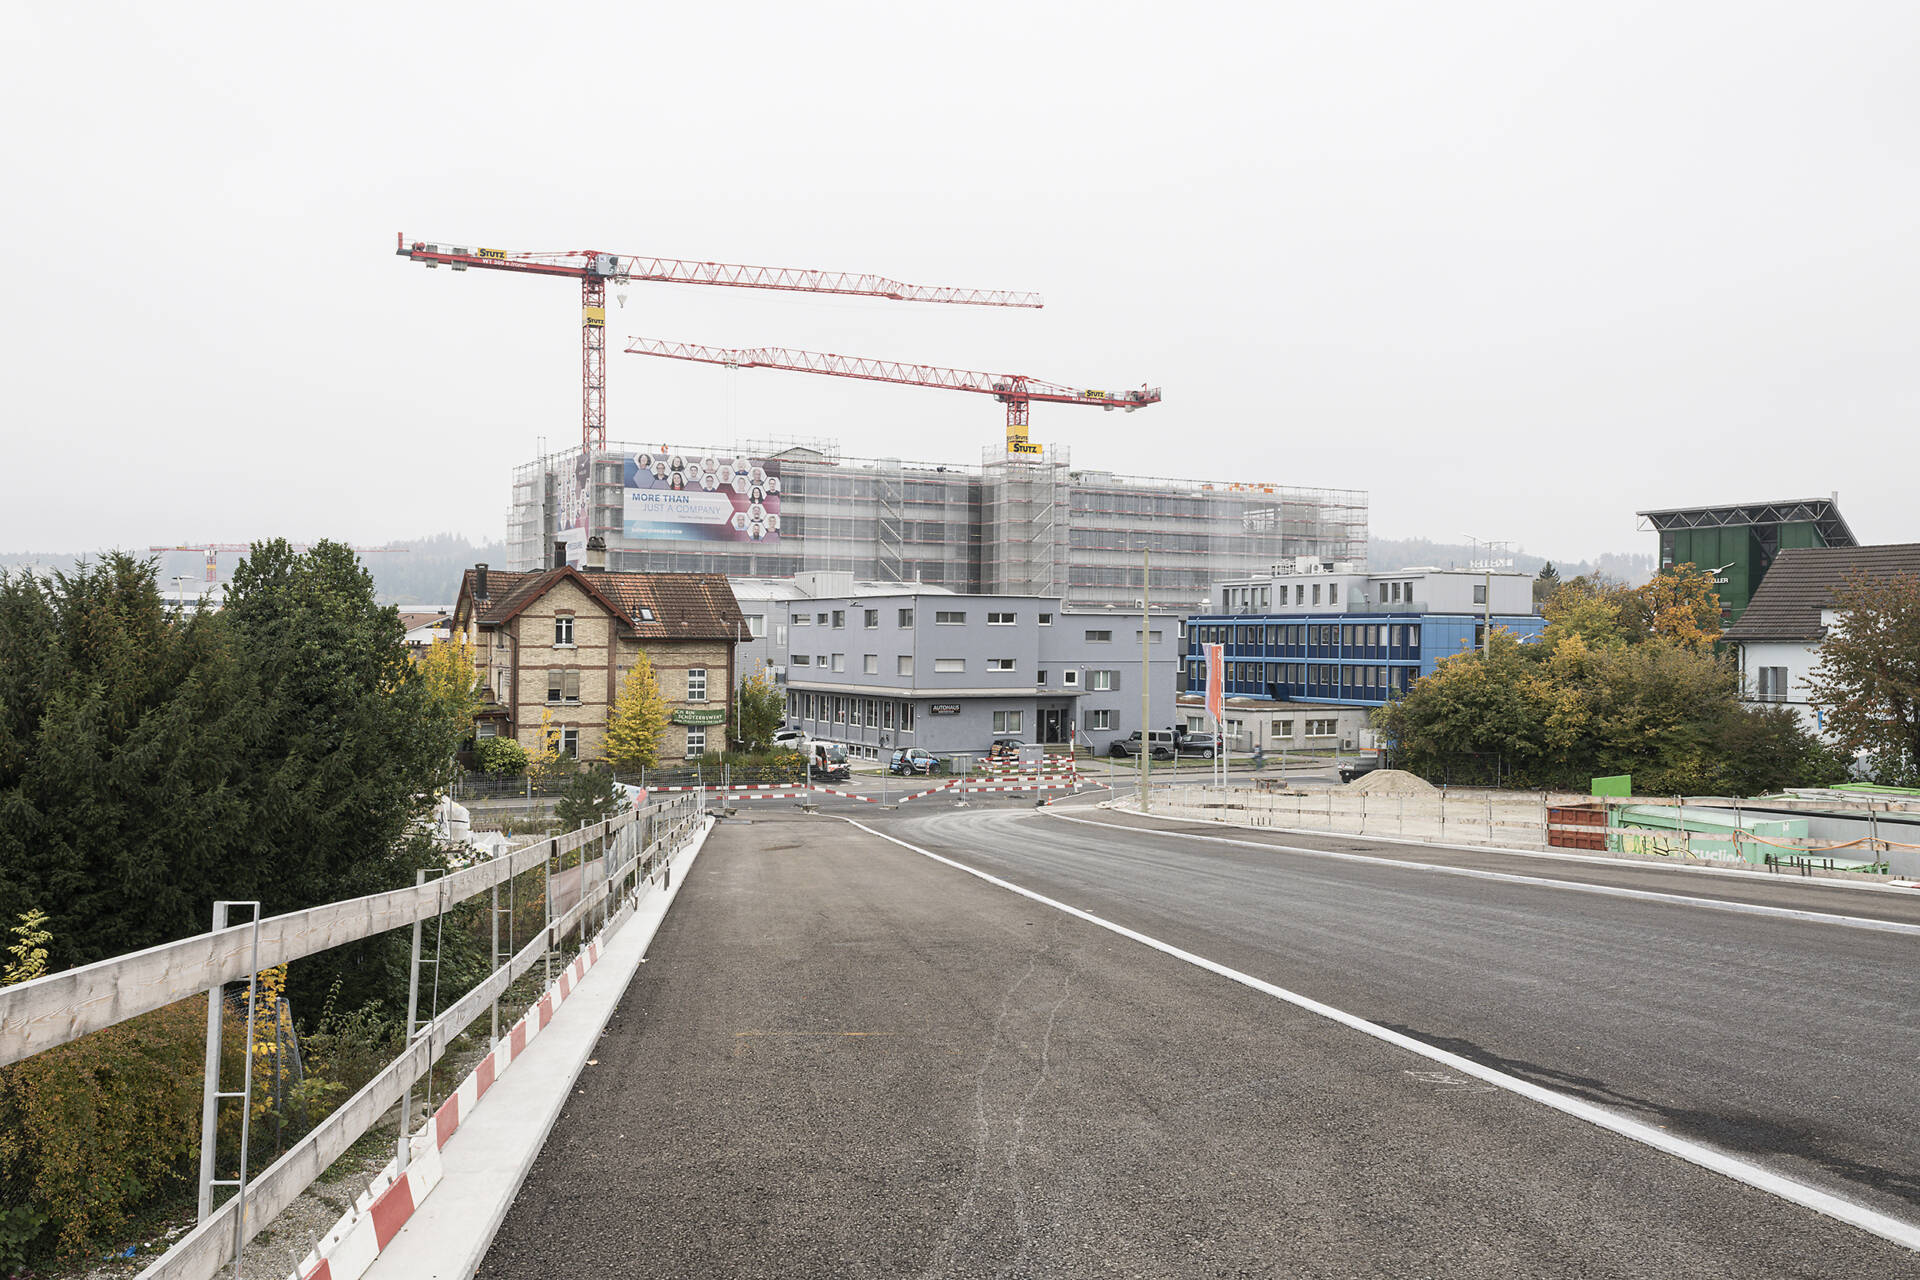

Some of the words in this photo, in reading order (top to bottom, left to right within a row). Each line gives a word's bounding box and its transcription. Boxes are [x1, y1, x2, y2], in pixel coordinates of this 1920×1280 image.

[479, 248, 505, 259] STUTZ
[1086, 389, 1104, 398] STUTZ
[1013, 443, 1037, 453] STUTZ
[632, 493, 660, 502] MORE
[663, 494, 689, 504] THAN
[643, 503, 665, 512] JUST
[667, 504, 674, 512] A
[675, 504, 721, 515] COMPANY
